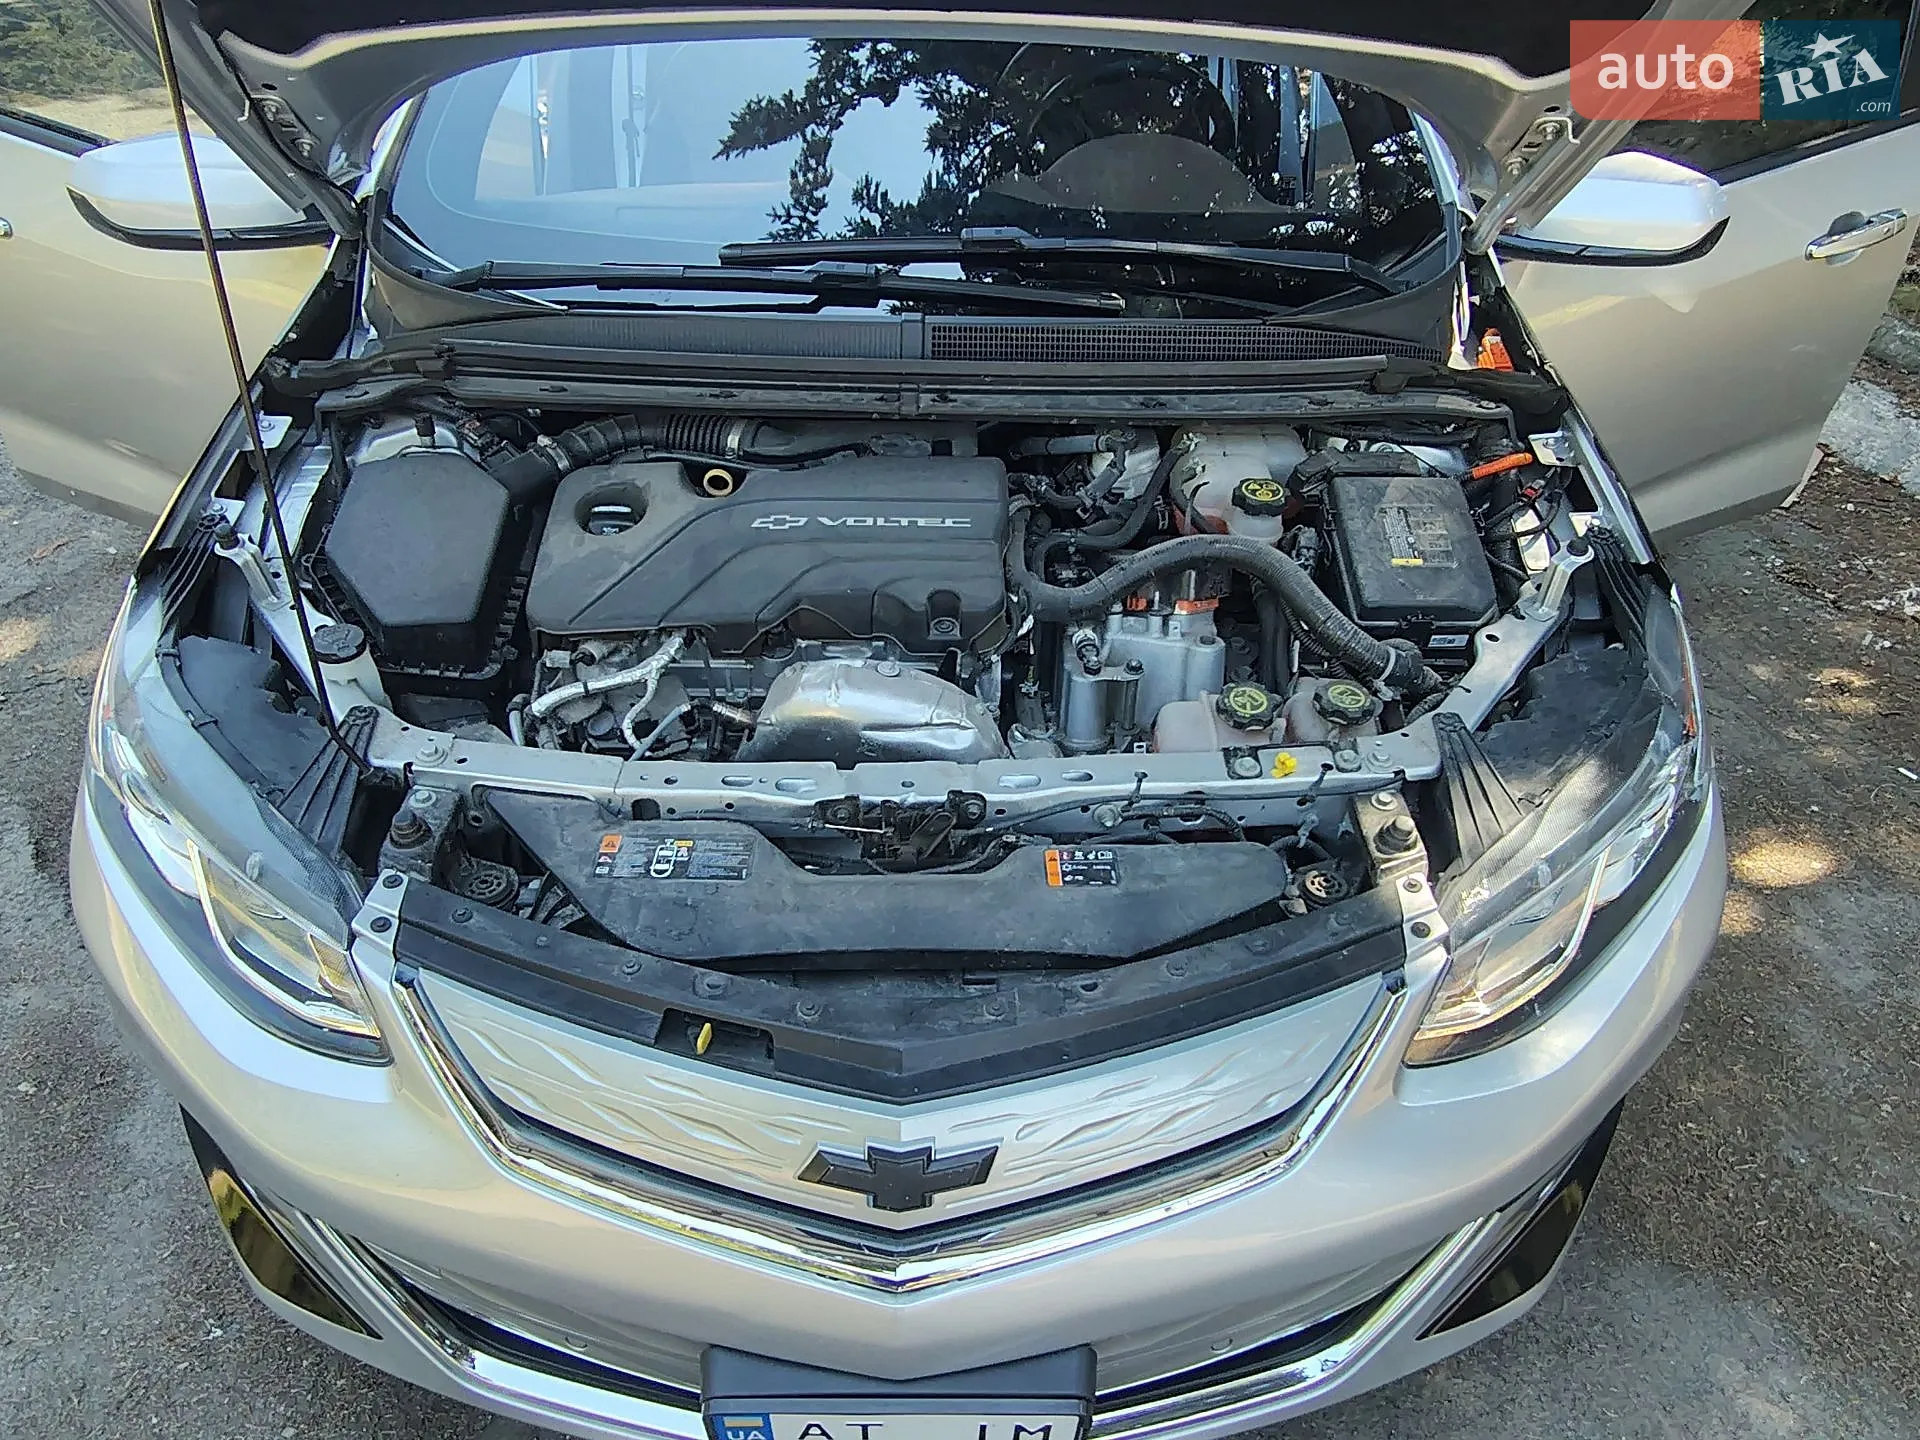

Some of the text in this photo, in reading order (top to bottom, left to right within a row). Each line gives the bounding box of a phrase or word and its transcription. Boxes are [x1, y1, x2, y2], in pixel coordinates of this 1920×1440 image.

[817, 517, 971, 528] VOLTEC
[726, 1431, 767, 1440] UA
[798, 1423, 883, 1440] AT
